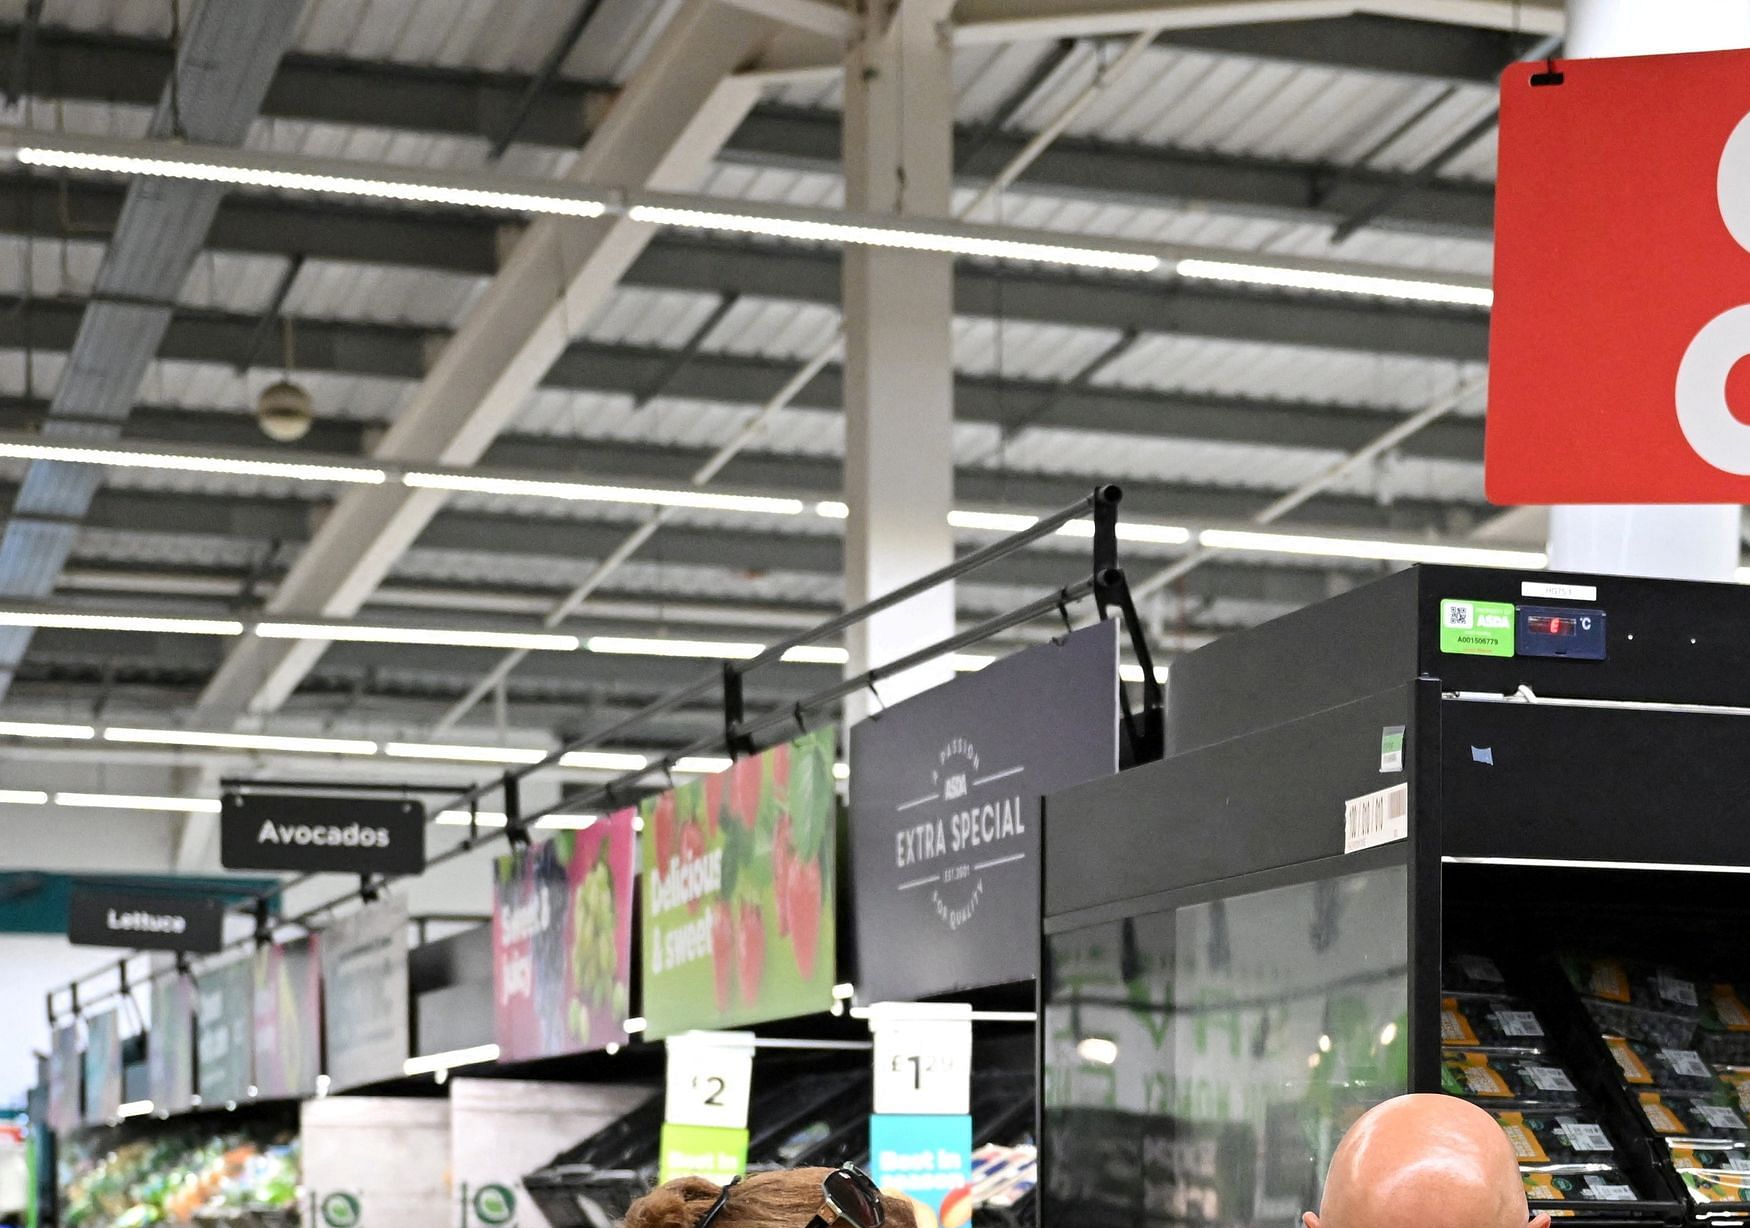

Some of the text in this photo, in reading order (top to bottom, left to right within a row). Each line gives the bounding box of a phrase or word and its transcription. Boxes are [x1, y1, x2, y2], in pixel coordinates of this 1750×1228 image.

[258, 819, 390, 848] Avocados
[897, 795, 1025, 868] EXTRA SPECIAL
[651, 846, 722, 917] Delicious
[107, 908, 187, 934] Lettuce
